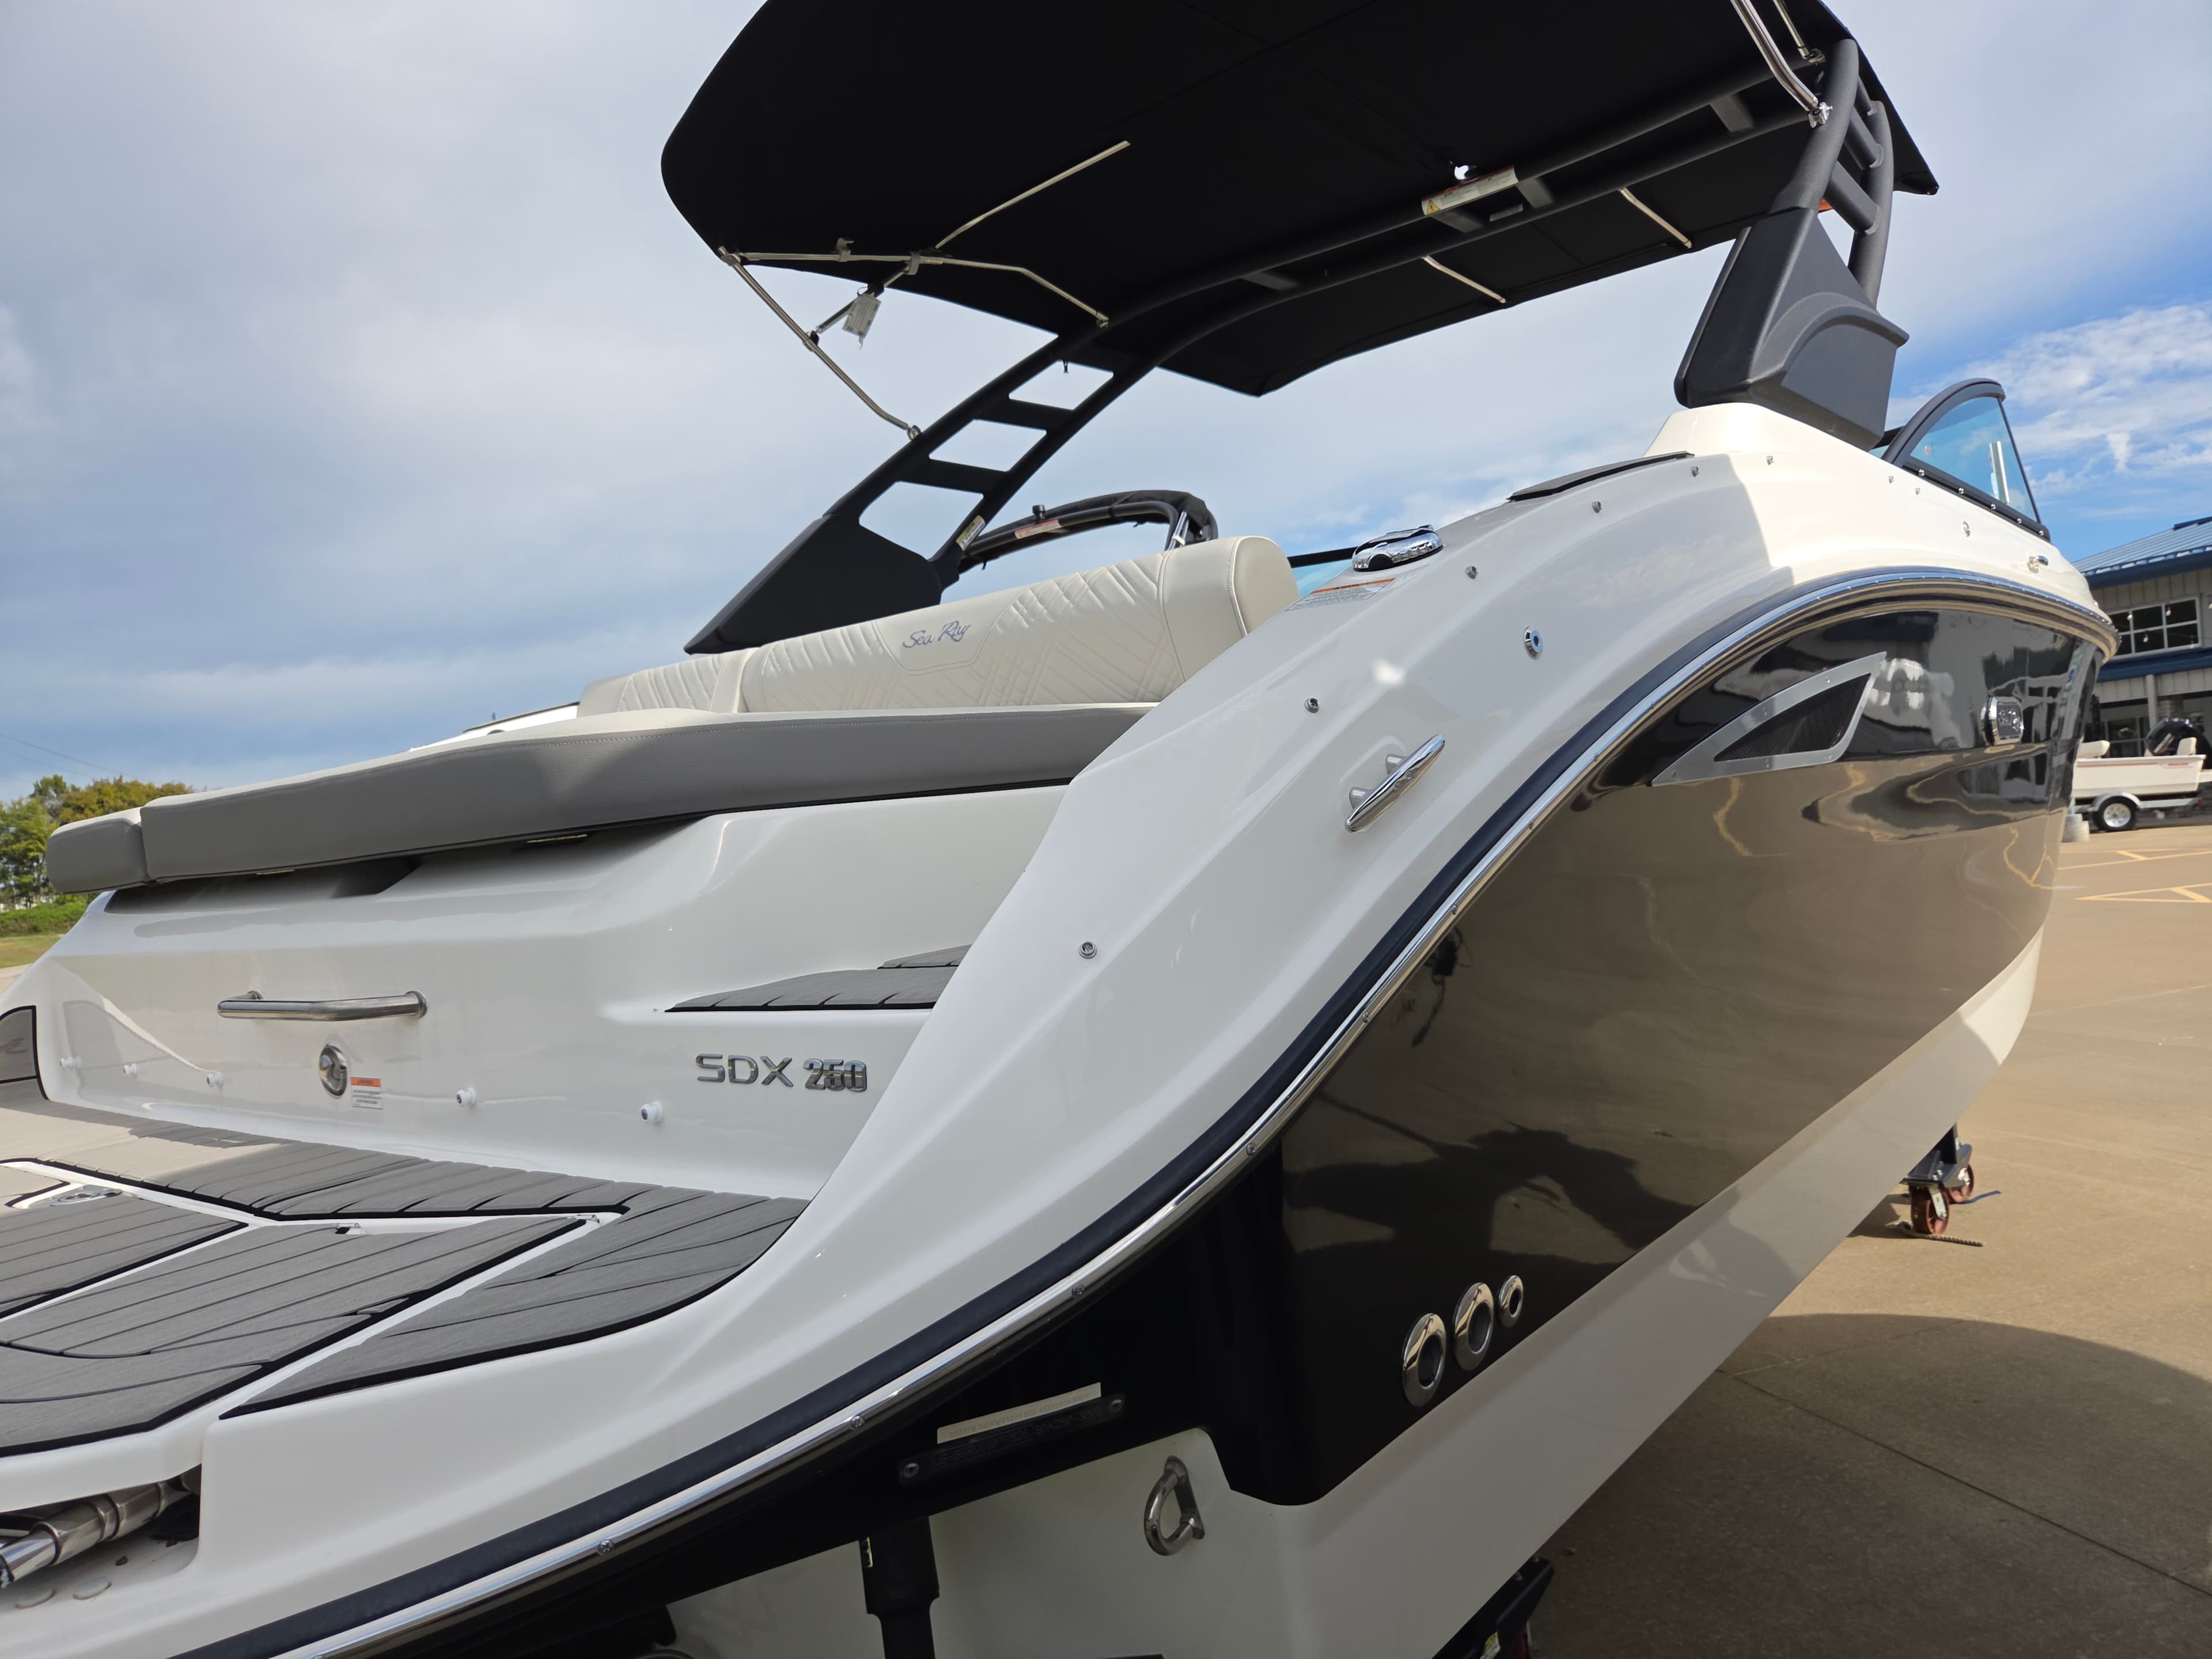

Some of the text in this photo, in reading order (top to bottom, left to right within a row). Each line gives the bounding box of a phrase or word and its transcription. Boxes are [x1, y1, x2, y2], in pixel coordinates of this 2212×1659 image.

[903, 620, 971, 648] Sea Ray
[696, 1054, 868, 1092] SDX 250
